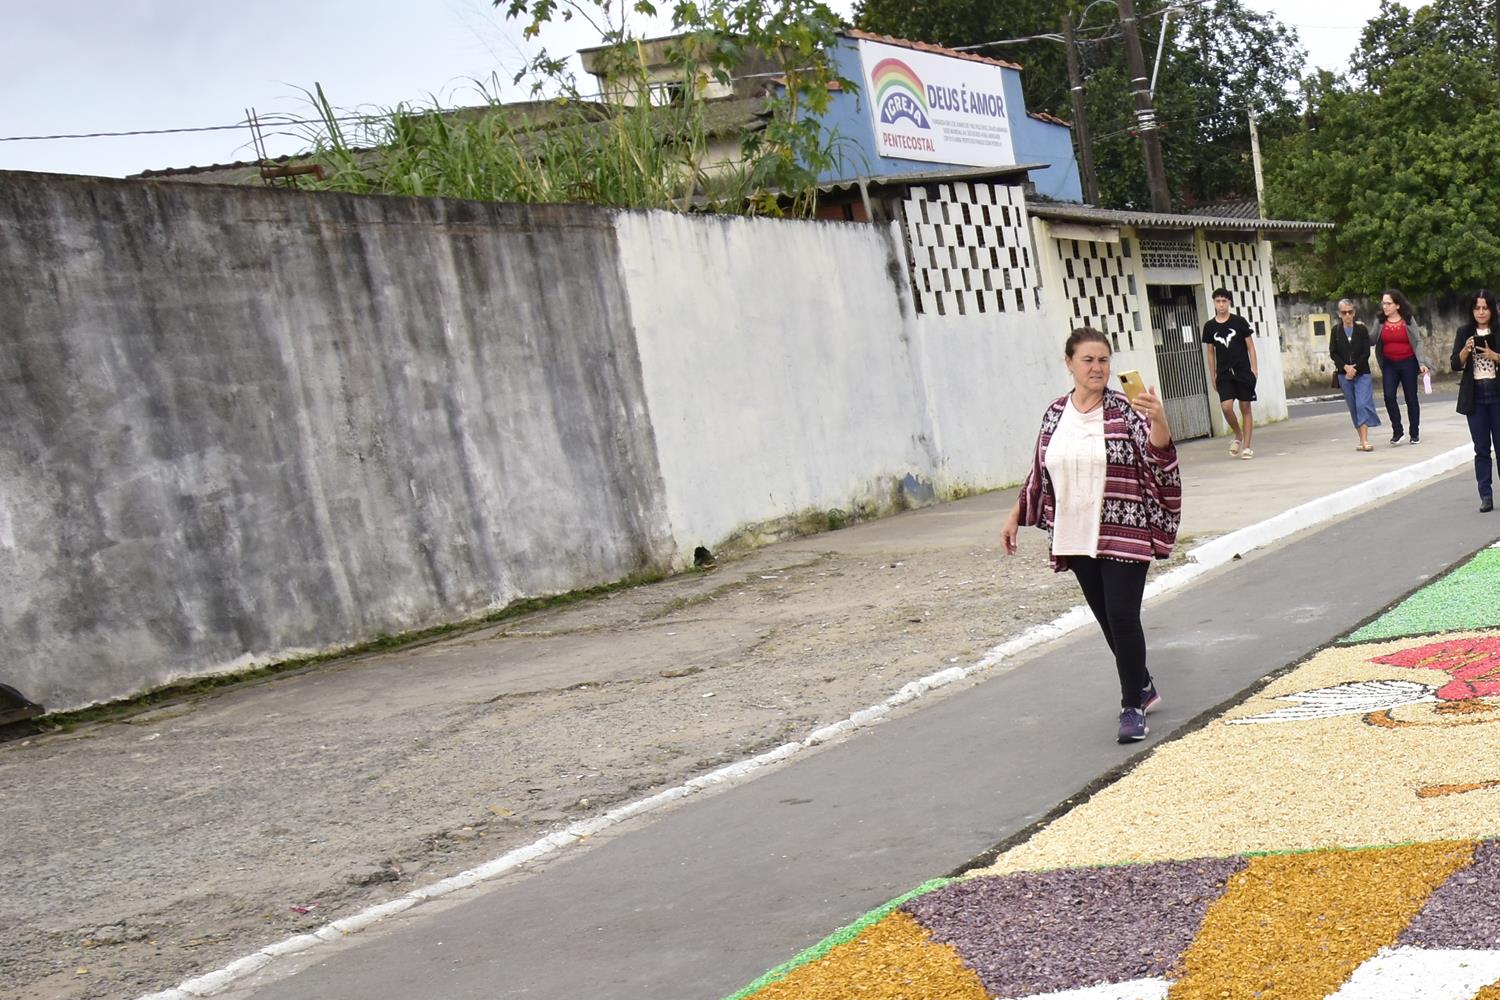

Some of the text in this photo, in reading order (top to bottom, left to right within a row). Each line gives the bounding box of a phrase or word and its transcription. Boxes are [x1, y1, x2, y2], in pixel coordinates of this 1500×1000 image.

[884, 95, 922, 126] IGREJA
[927, 82, 1005, 118] DEUS É AMOR
[883, 132, 935, 152] PENTECOSTAL
